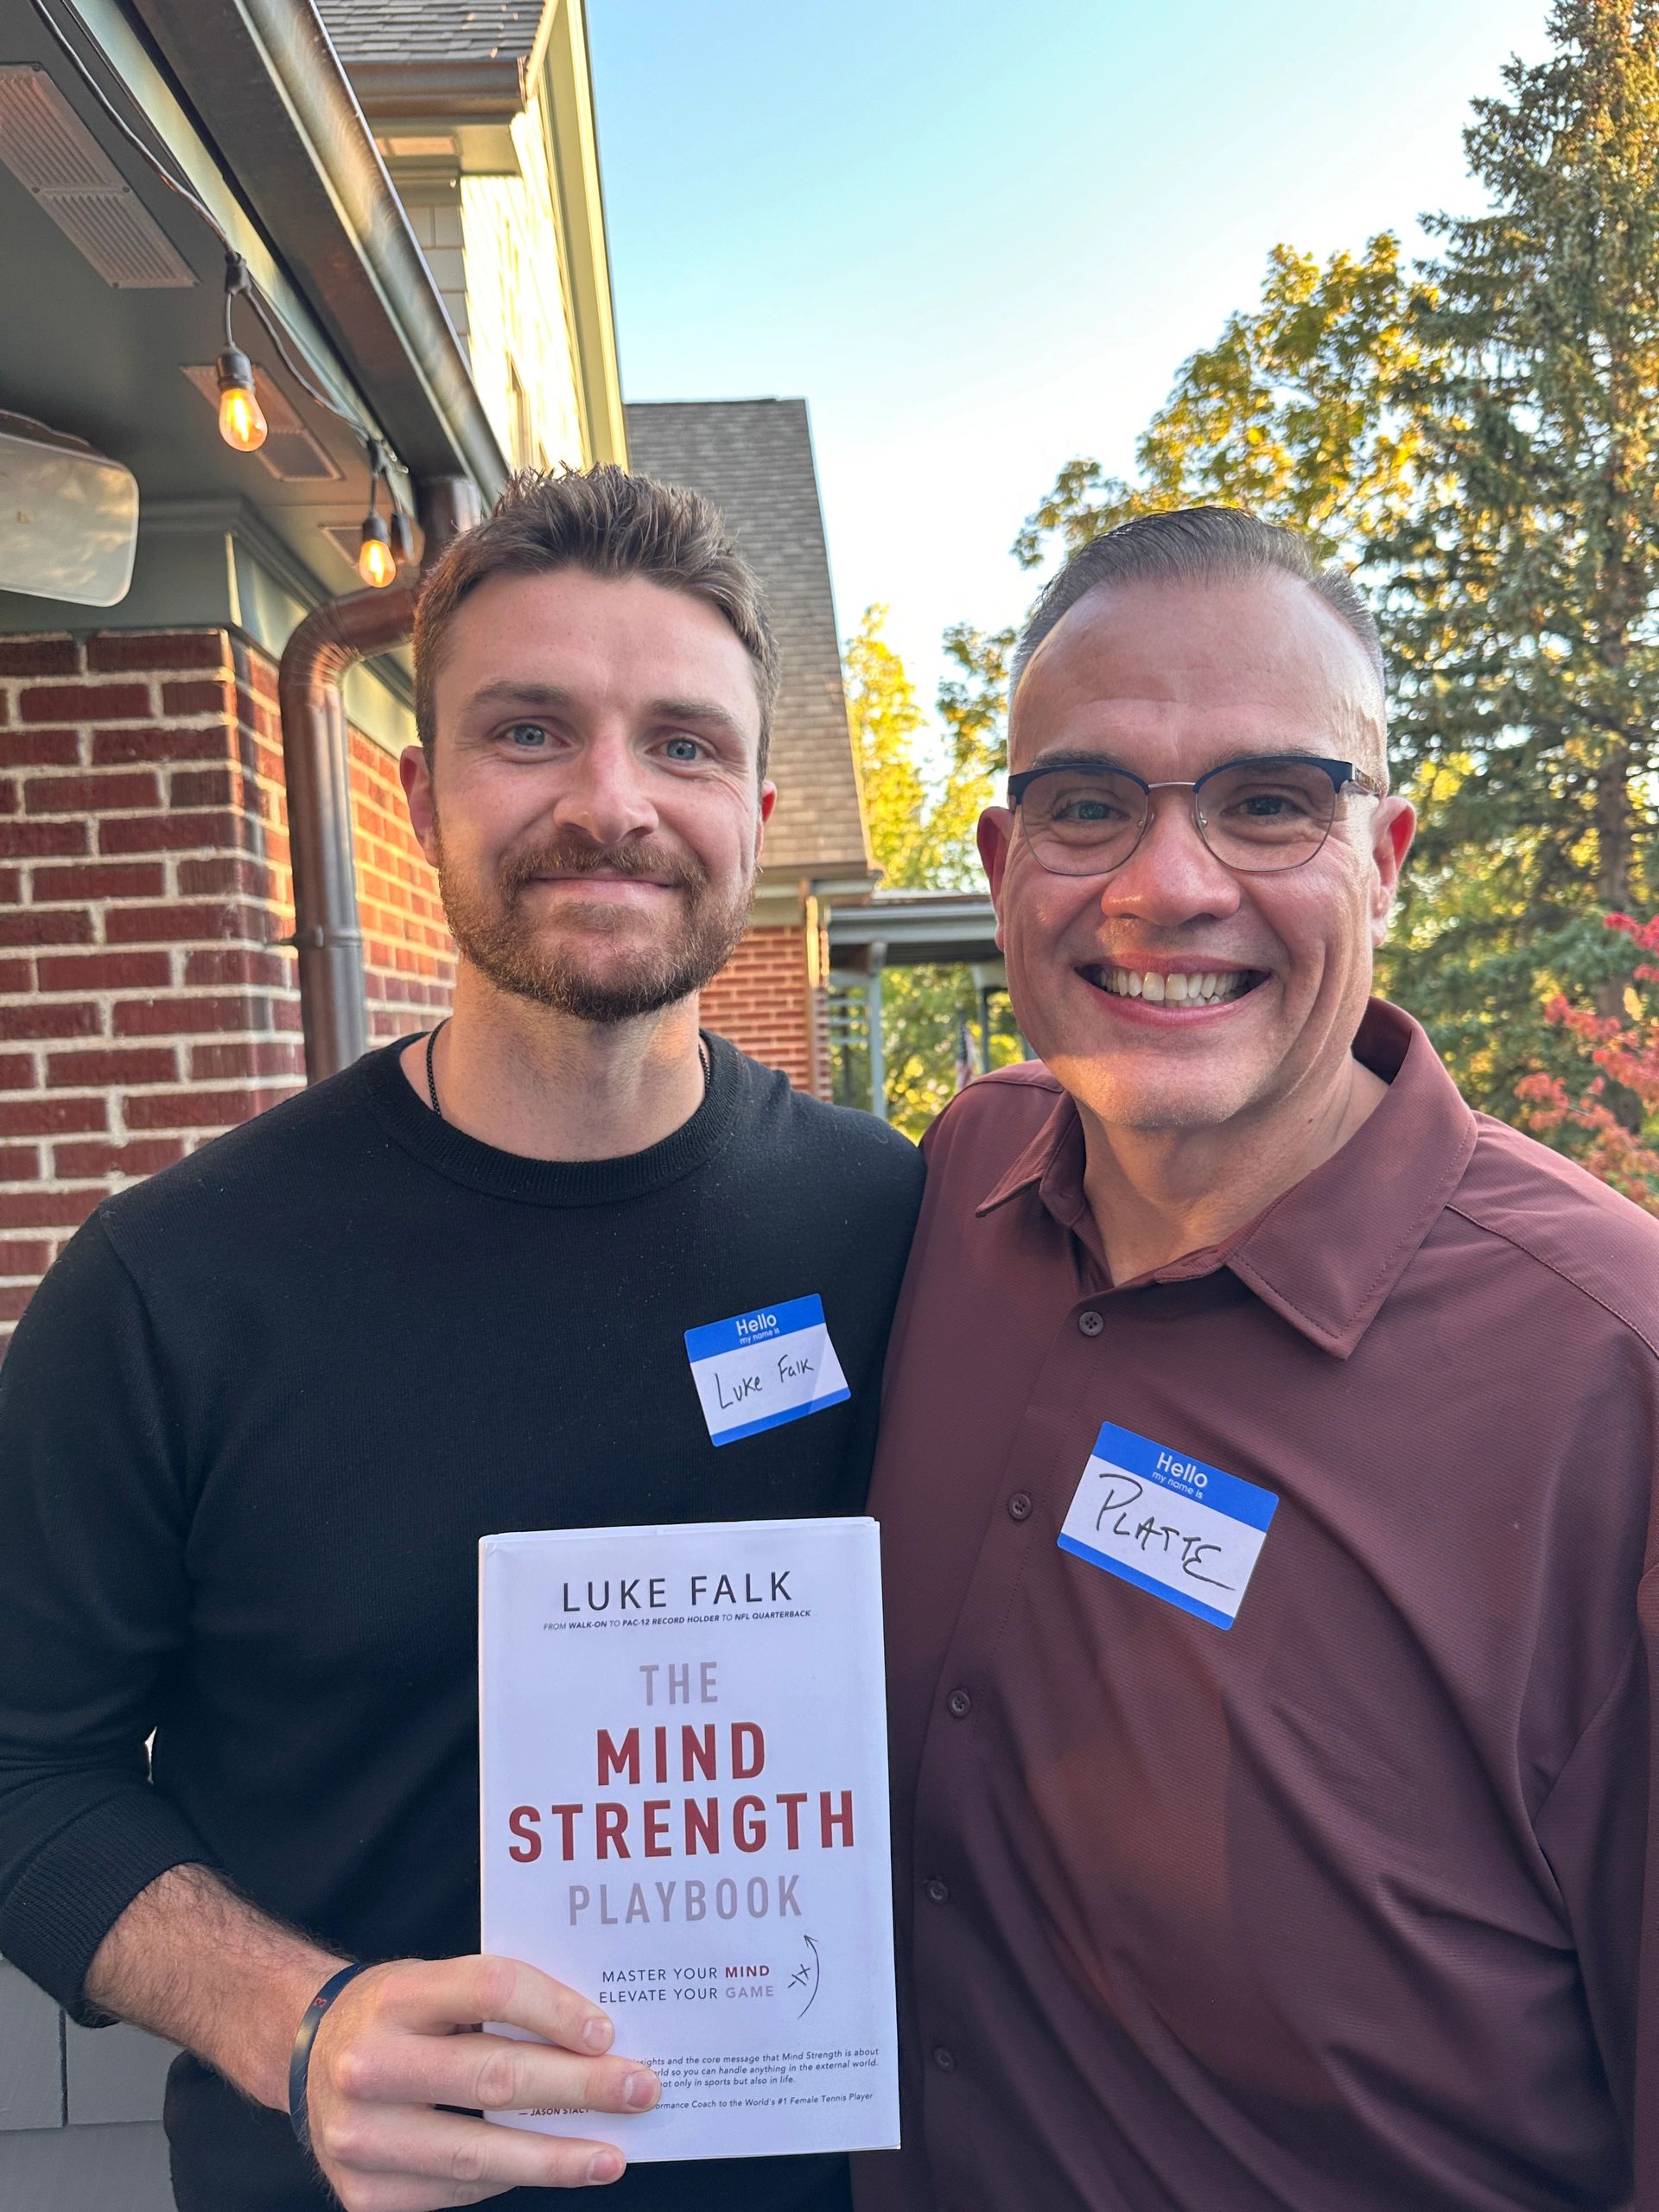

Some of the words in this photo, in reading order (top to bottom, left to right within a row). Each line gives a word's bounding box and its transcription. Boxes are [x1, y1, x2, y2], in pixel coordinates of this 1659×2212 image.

[735, 1313, 777, 1336] Hello
[740, 1336, 752, 1344] my
[753, 1330, 773, 1341] name
[715, 1373, 763, 1409] Luke
[778, 1354, 814, 1382] Falk
[1156, 1452, 1208, 1488] Hello
[1152, 1471, 1165, 1484] my
[1167, 1478, 1193, 1495] name
[1195, 1486, 1204, 1499] is
[1096, 1473, 1236, 1591] PLATTE
[563, 1578, 667, 1612] LUKE
[691, 1571, 792, 1605] FALK
[543, 1622, 567, 1630] FROM
[569, 1620, 607, 1630] WALK-ON
[622, 1618, 651, 1627] PAC-12
[652, 1617, 685, 1625] RECORD
[687, 1614, 720, 1623] HOLDER
[734, 1612, 750, 1621] NFL
[752, 1610, 810, 1619] QUARTERBACK
[639, 1662, 719, 1706] THE
[596, 1721, 766, 1786] MIND
[508, 1789, 855, 1863] STRENGTH
[569, 1875, 802, 1926] PLAYBOOK
[602, 1968, 666, 1982] MASTER
[673, 1967, 718, 1980] YOUR
[725, 1965, 770, 1978] MIND
[600, 1989, 667, 2003] ELEVATE
[674, 1987, 718, 2000] YOUR
[726, 1986, 774, 1998] GAME
[667, 2056, 683, 2065] and
[686, 2056, 700, 2064] the
[723, 2056, 760, 2064] message
[763, 2053, 779, 2062] that
[782, 2052, 804, 2061] Mind
[806, 2050, 842, 2060] Strength
[854, 2048, 879, 2056] about
[719, 2066, 747, 2075] handle
[750, 2064, 786, 2075] anything
[816, 2060, 850, 2070] external
[852, 2059, 879, 2068] world.
[674, 2079, 692, 2088] only
[705, 2079, 731, 2088] sports
[780, 2075, 796, 2083] life.
[691, 2100, 716, 2108] Coach
[745, 2097, 775, 2106] World's
[790, 2095, 818, 2105] Female
[849, 2092, 873, 2101] Player
